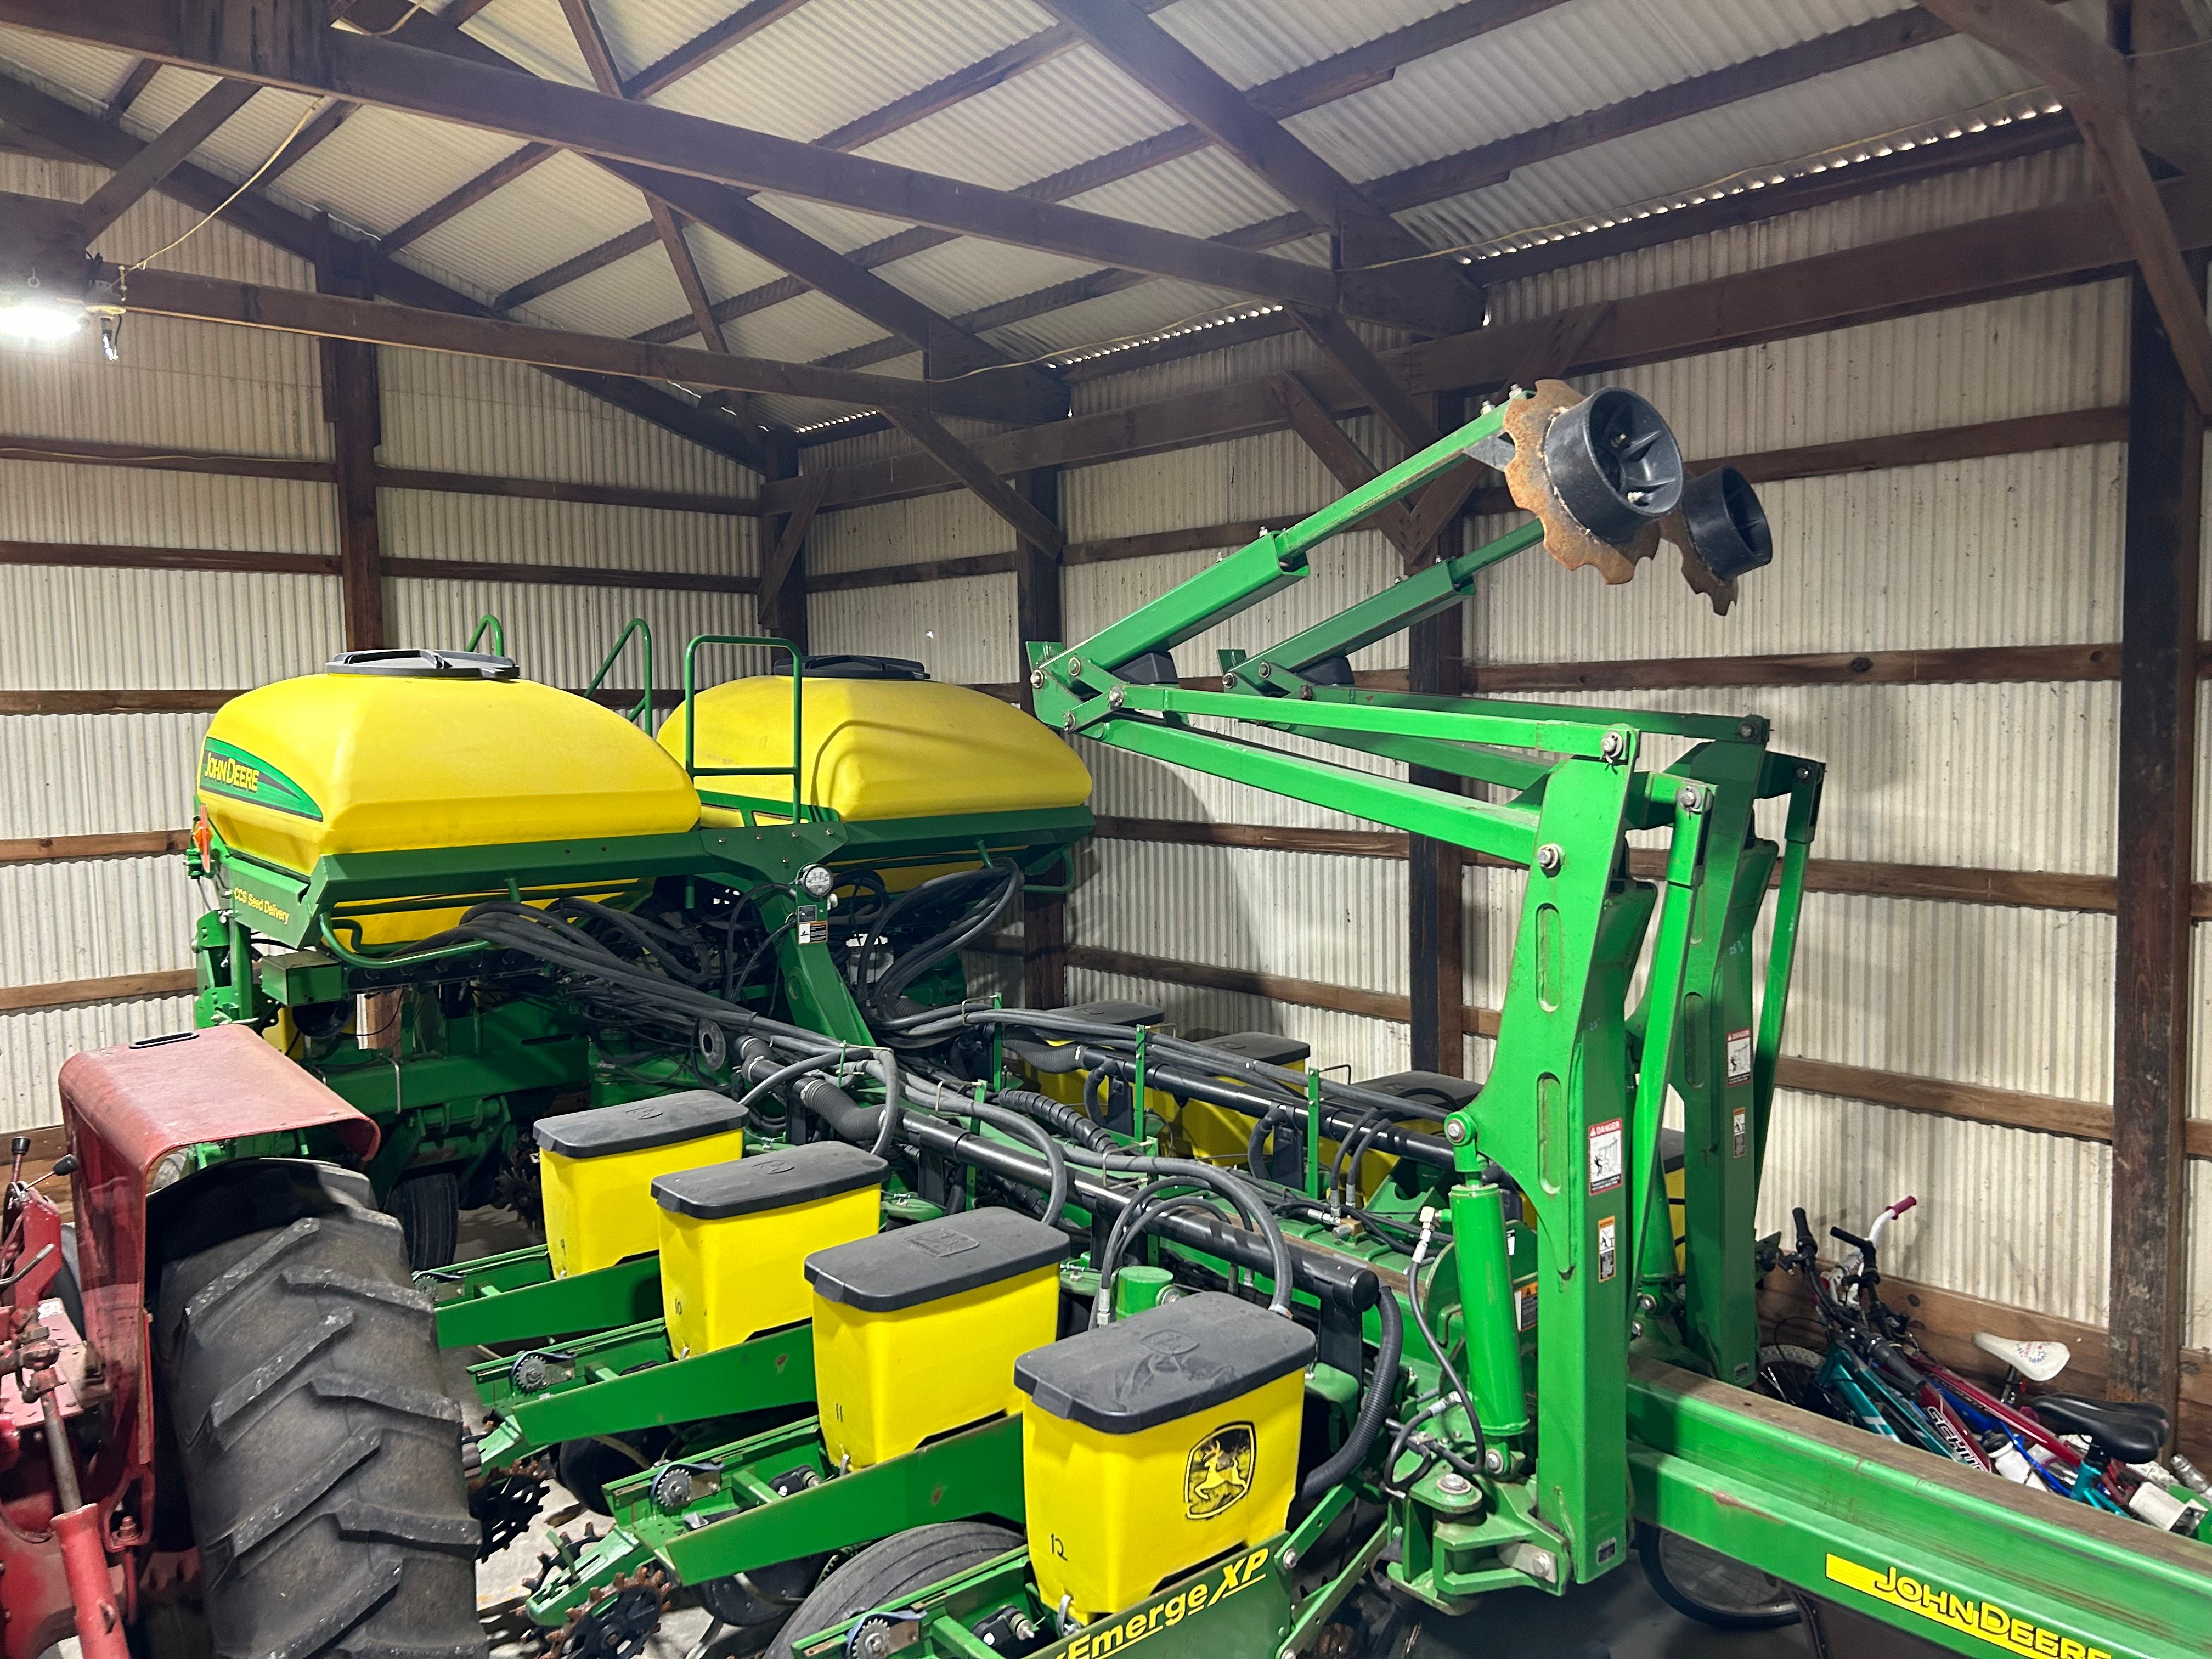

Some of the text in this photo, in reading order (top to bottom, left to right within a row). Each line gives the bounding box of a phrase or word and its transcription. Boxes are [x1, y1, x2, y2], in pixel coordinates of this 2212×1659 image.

[205, 752, 260, 792] JOHN DEERE
[234, 887, 290, 926] CCS Seed Delivery
[1595, 1120, 1621, 1136] DANGER
[560, 1239, 566, 1257] 9
[1050, 1533, 1069, 1562] 12
[1056, 1548, 1269, 1659] Emerge XP
[1875, 1566, 1974, 1624] JOHN
